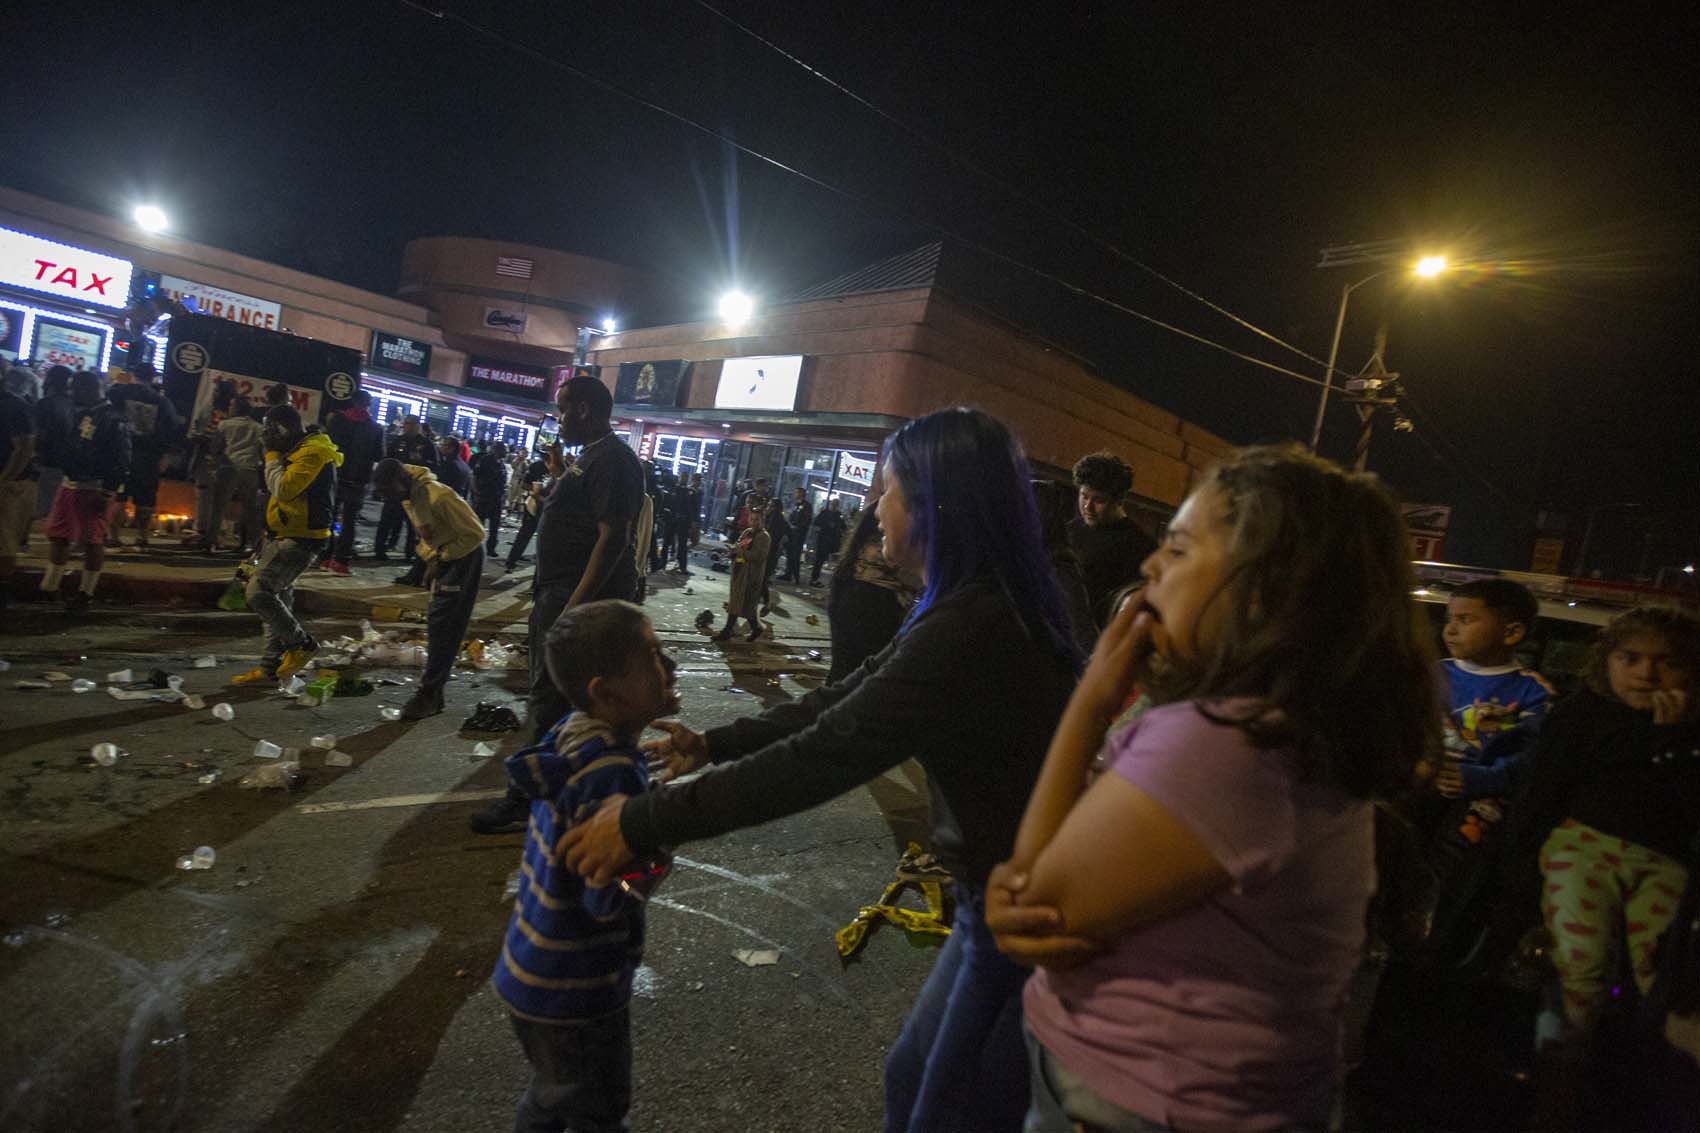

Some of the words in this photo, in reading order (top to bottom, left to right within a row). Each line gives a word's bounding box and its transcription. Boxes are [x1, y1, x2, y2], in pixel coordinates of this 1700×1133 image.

[34, 259, 113, 296] TAX
[165, 287, 275, 331] INURANCE
[471, 366, 490, 379] THE
